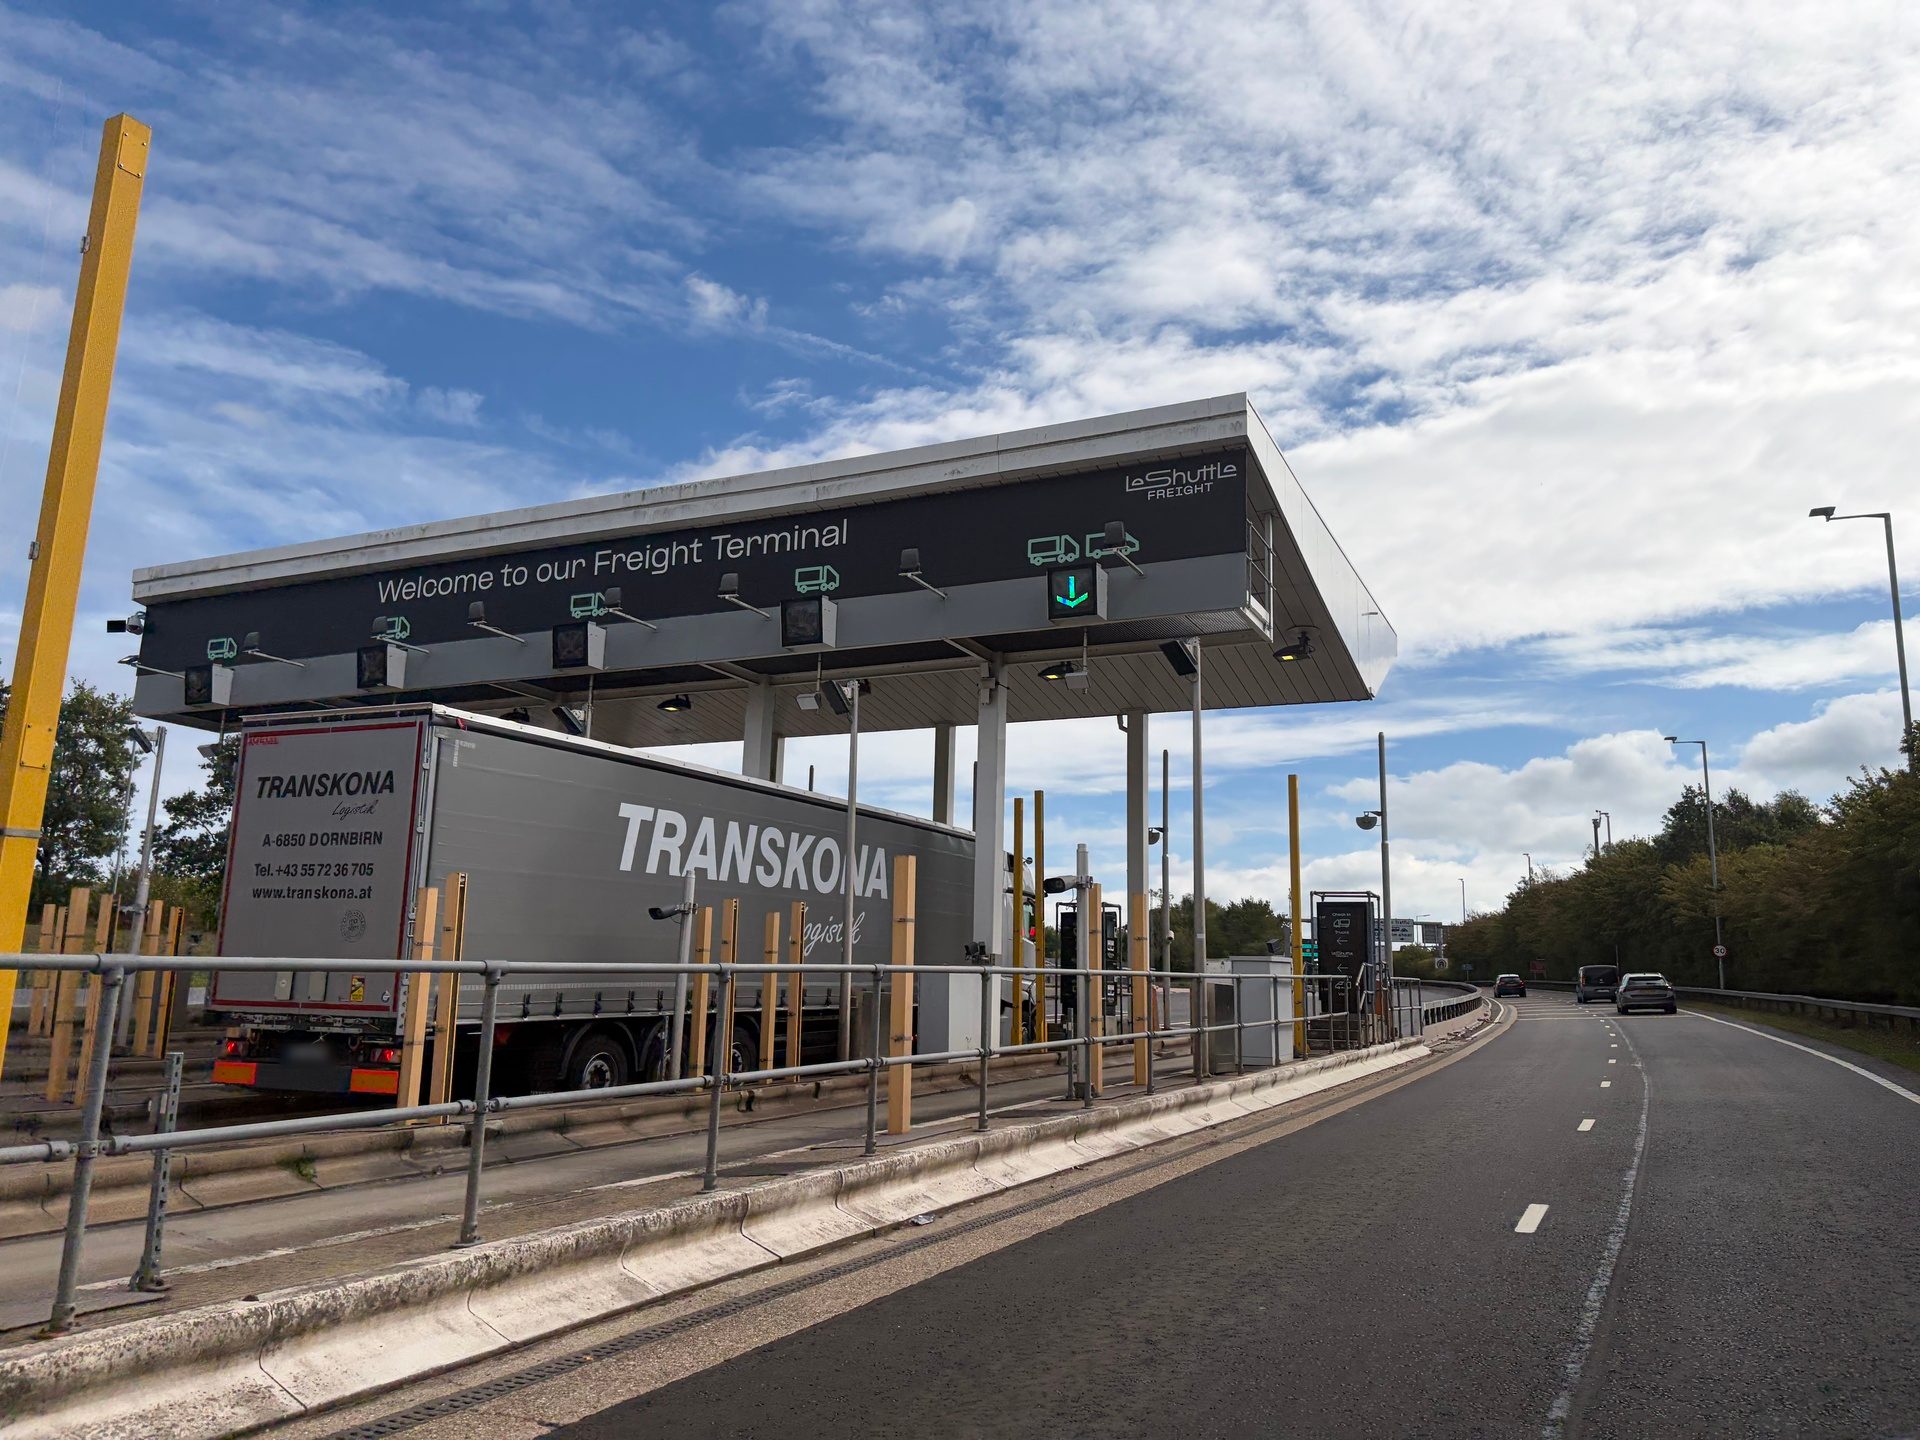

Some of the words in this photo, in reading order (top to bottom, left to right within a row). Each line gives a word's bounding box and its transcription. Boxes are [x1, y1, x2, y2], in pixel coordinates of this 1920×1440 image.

[1126, 462, 1237, 492] LeShuttle
[1147, 482, 1214, 500] FREIGHT
[378, 571, 494, 603] Welcome
[500, 563, 528, 587] to
[536, 558, 586, 583] our
[594, 538, 703, 575] Freight
[711, 518, 848, 560] Terminal
[257, 770, 395, 799] TRANSKONA
[332, 800, 379, 820] Logistik
[262, 832, 306, 847] A-6850
[309, 831, 383, 846] DORNBIRN
[618, 802, 889, 900] TRANSKONA
[255, 863, 274, 877] Tel.
[275, 863, 298, 877] +43
[351, 862, 375, 877] 705
[252, 885, 373, 899] www.transkona.at
[1714, 947, 1725, 955] 30
